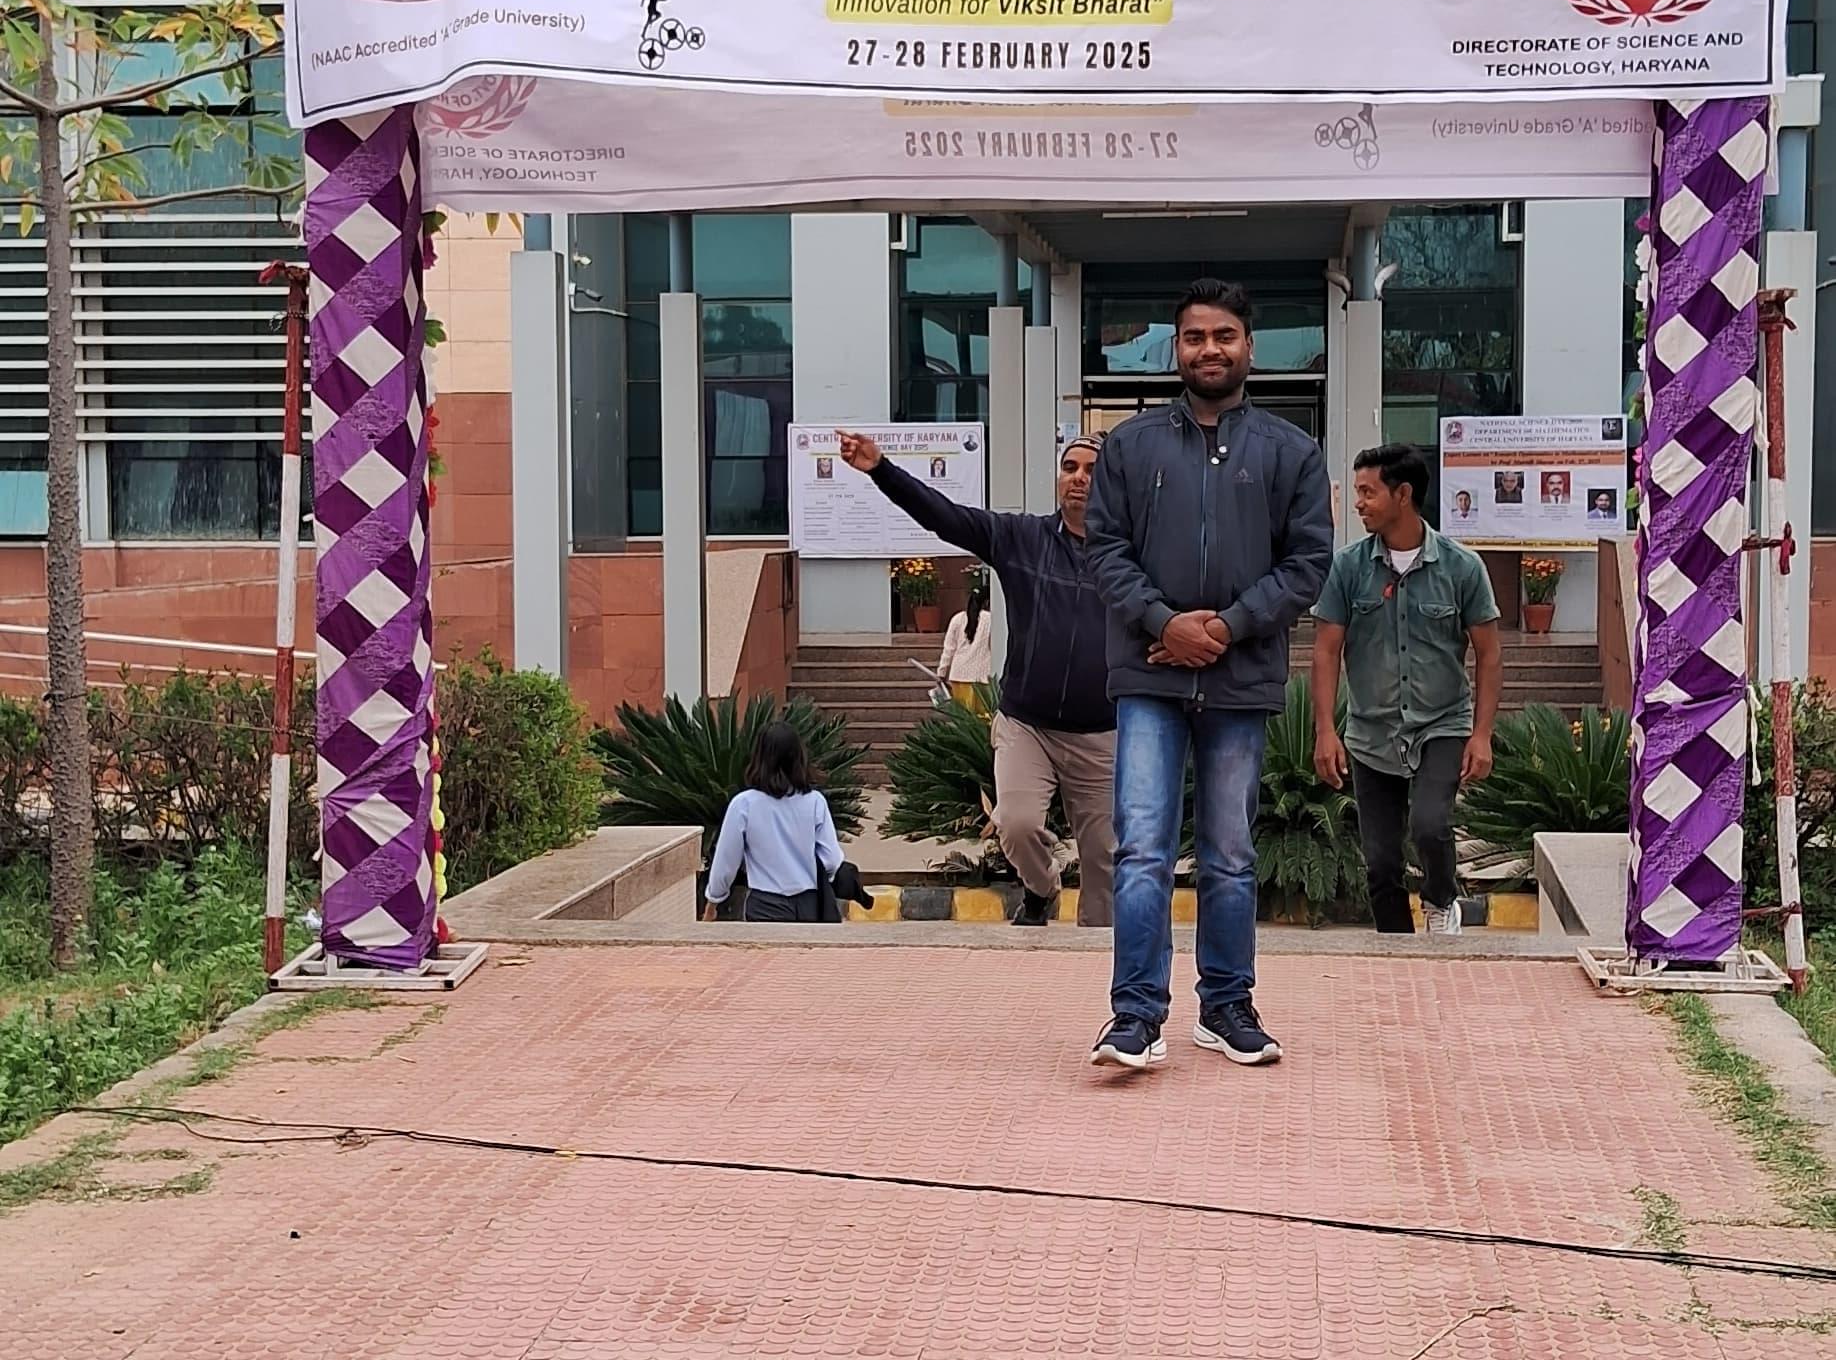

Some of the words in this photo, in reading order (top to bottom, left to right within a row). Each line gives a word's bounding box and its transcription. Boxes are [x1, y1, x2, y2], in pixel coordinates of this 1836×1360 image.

[311, 46, 352, 71] (NAAC
[355, 31, 437, 59] Accredited
[452, 10, 489, 34] Grade
[494, 8, 586, 33] University)
[1452, 38, 1581, 54] DIRECTORATE
[1587, 36, 1611, 51] OF
[1616, 34, 1699, 50] SCIENCE
[1704, 32, 1743, 47] AND
[848, 39, 925, 68] 27-28
[942, 41, 1069, 69] FEBRUARY
[1086, 41, 1151, 69] 2025
[1484, 60, 1615, 77] TECHNOLOGY,
[1621, 57, 1710, 73] HARYANA
